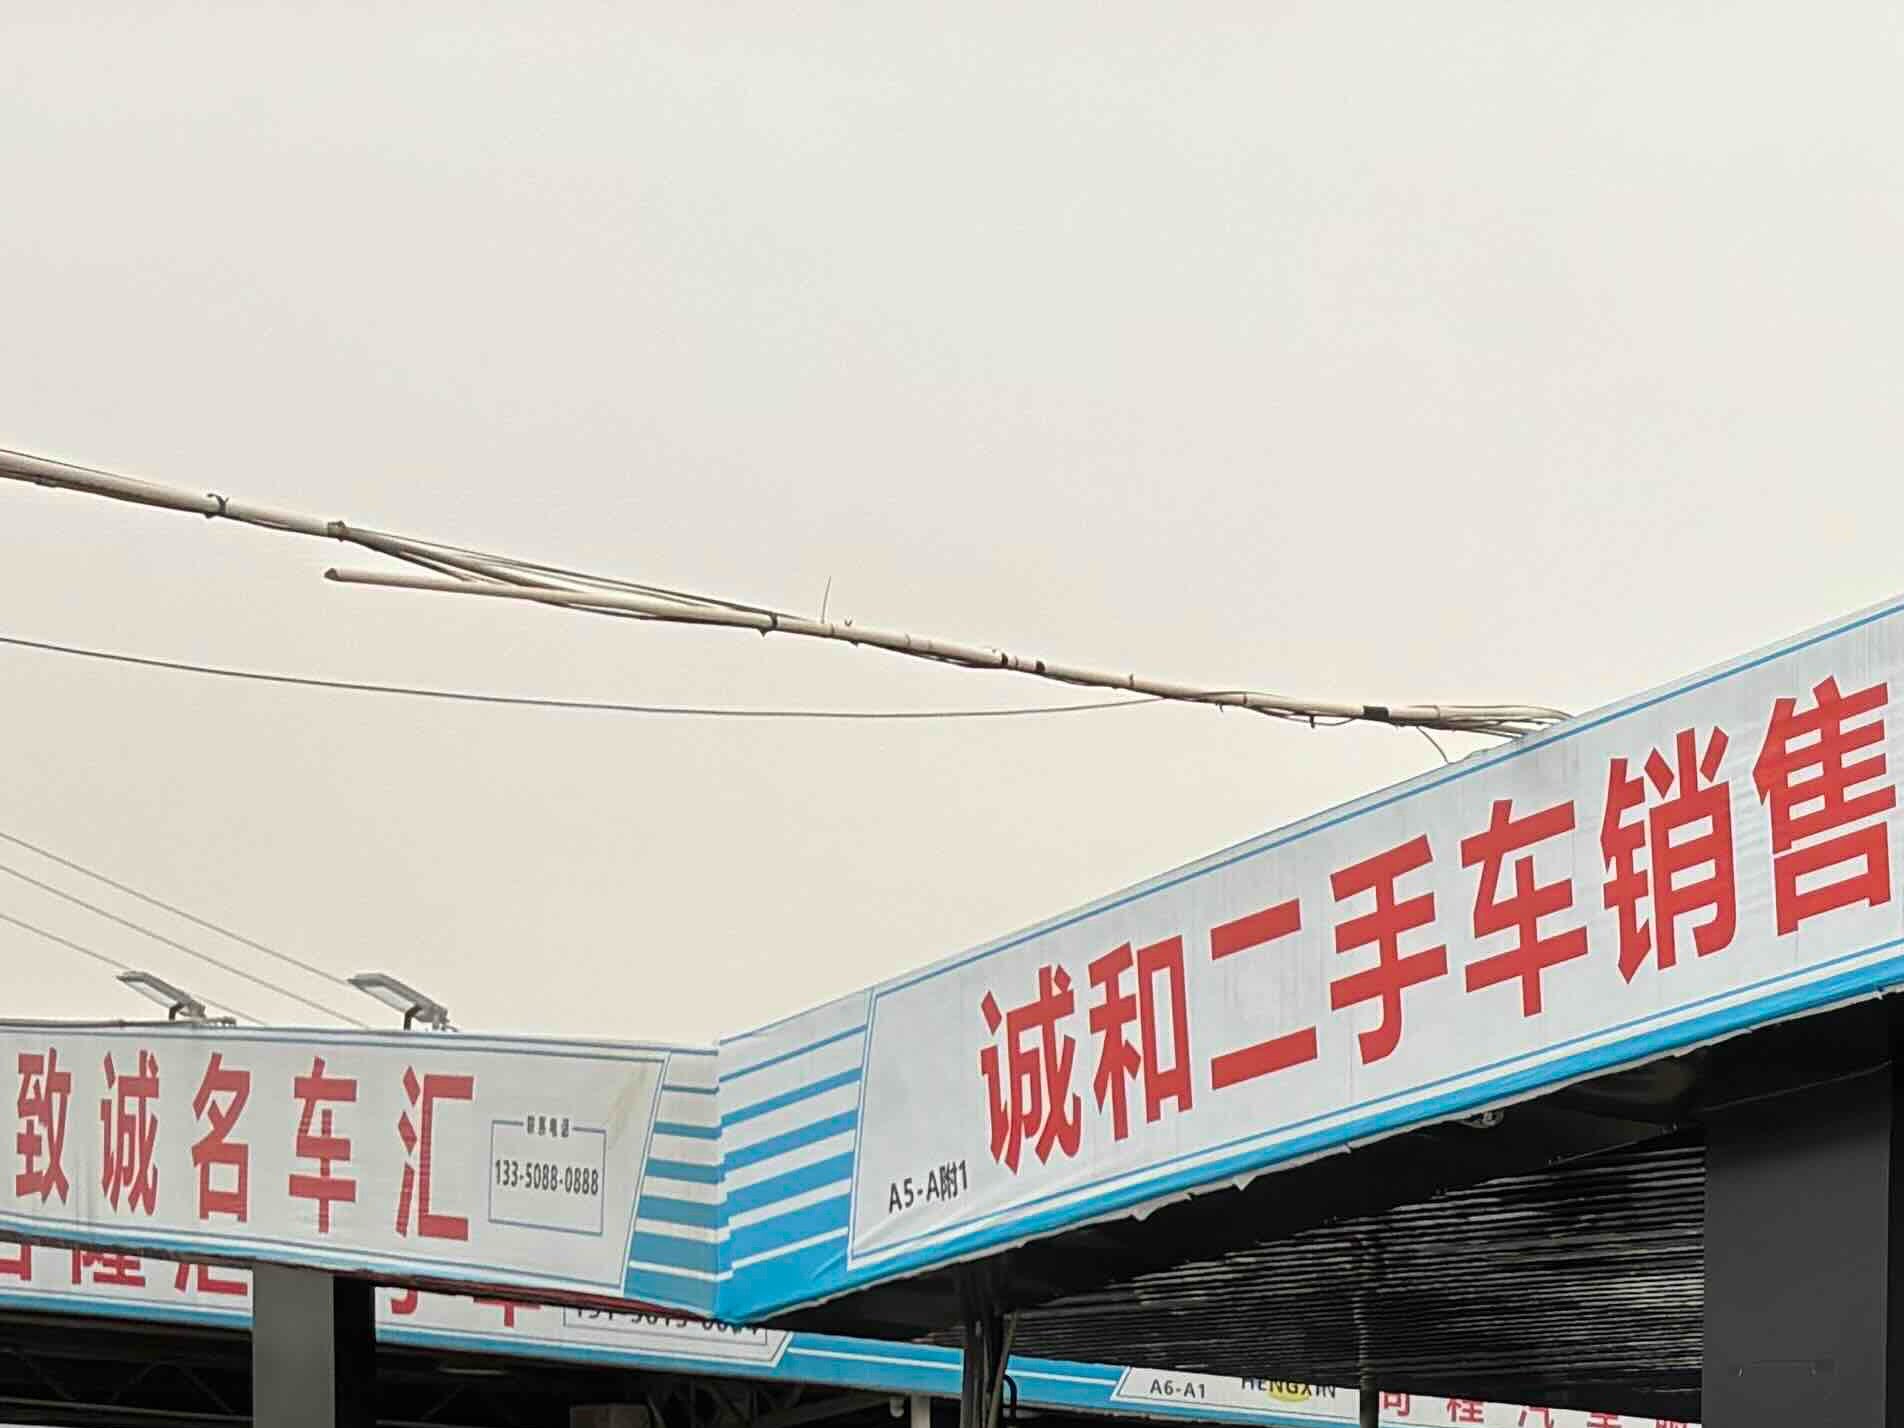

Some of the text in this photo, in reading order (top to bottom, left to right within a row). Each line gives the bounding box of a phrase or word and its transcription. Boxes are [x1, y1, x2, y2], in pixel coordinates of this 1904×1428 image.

[15, 1048, 474, 1242] 致诚名车汇
[495, 1159, 599, 1196] 133-5088-0888
[889, 1160, 968, 1214] A5-A附1
[1149, 1379, 1207, 1399] A6-A1
